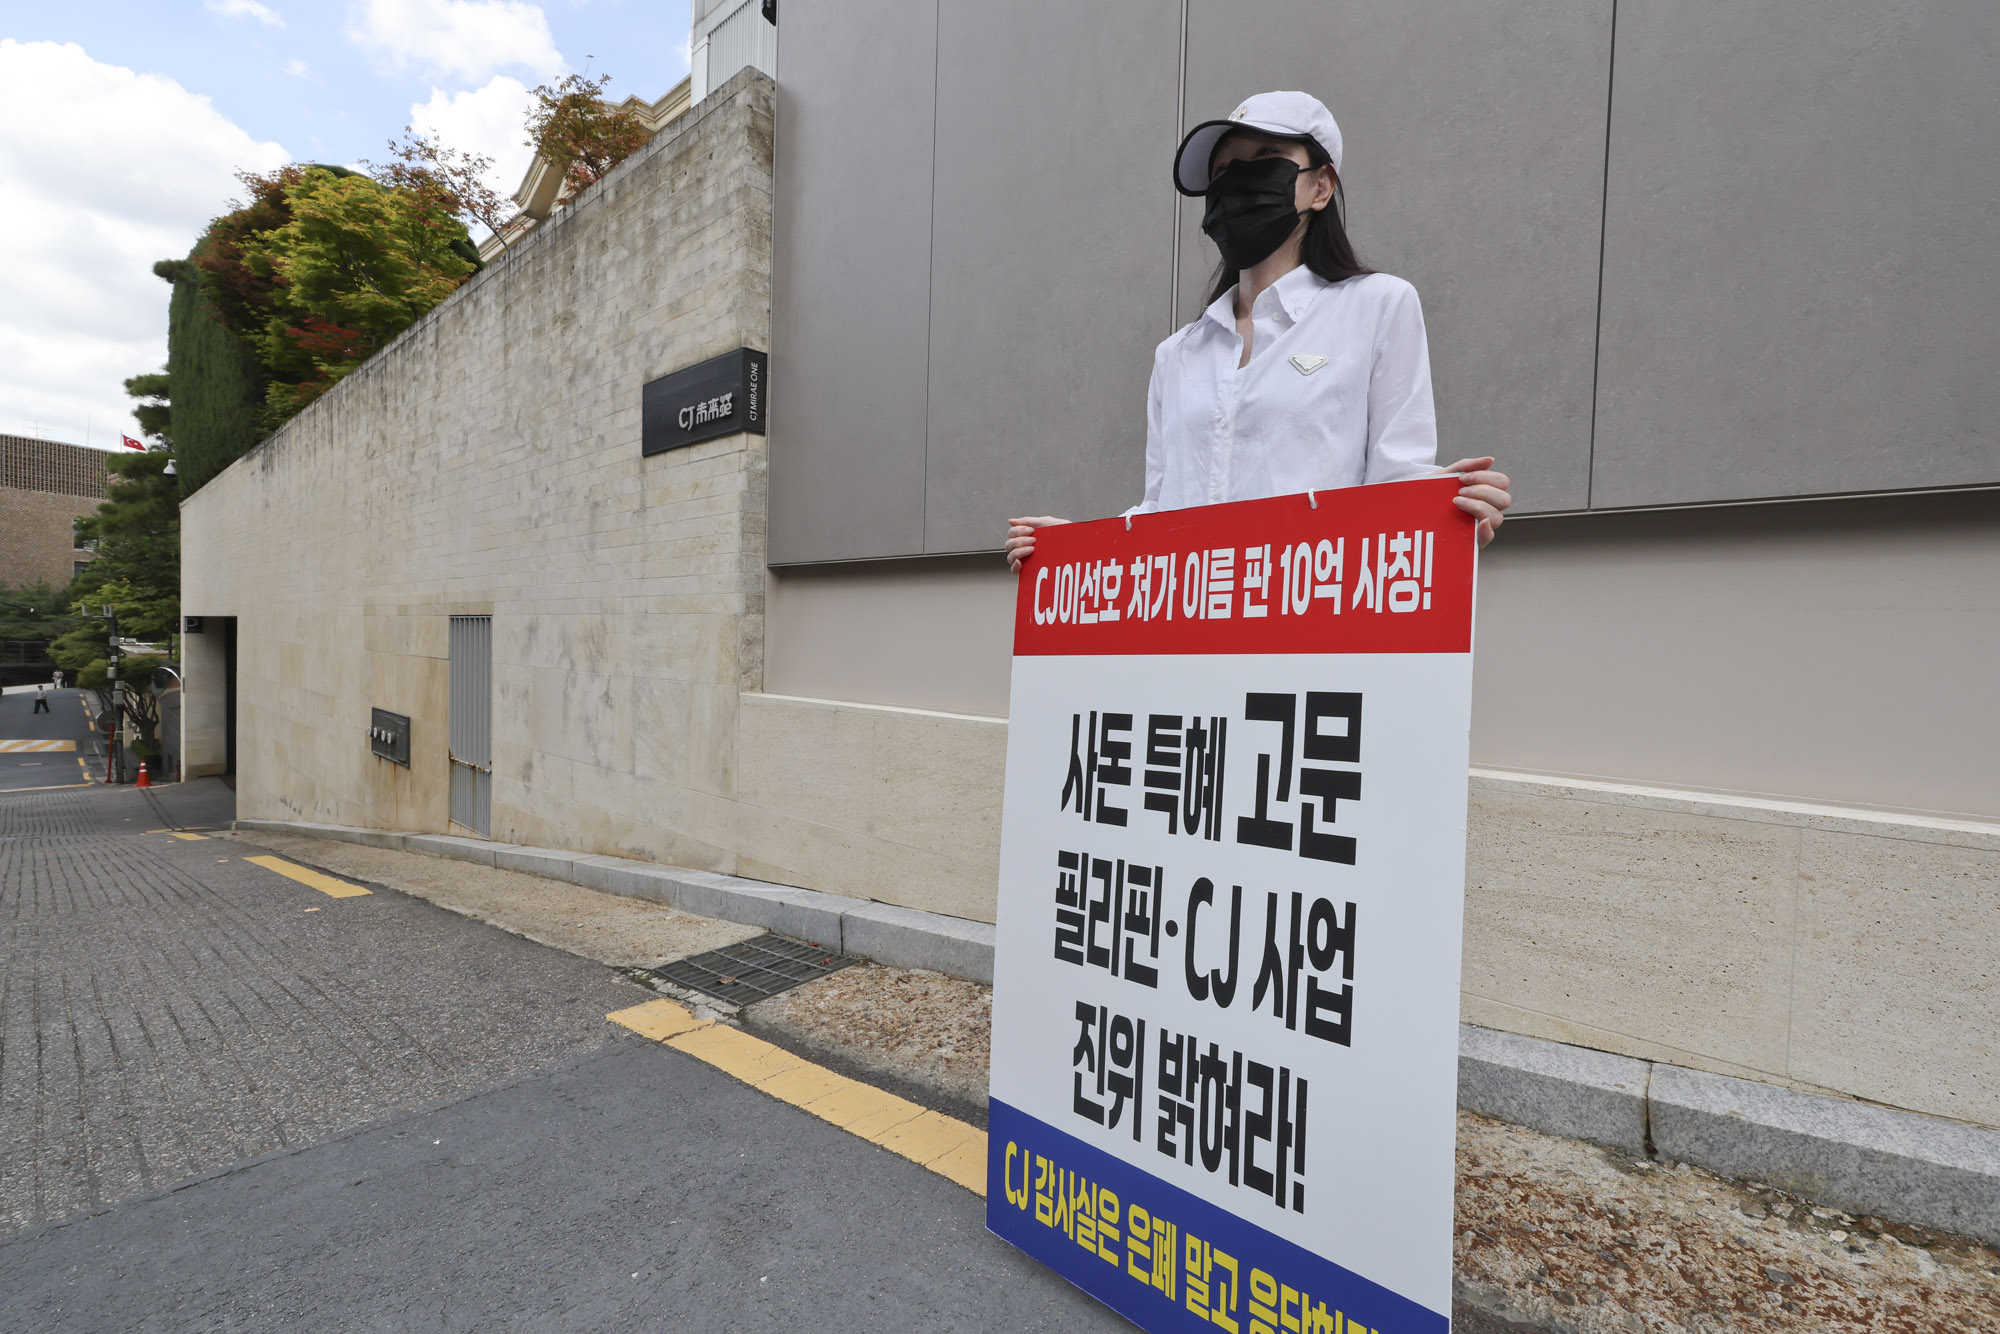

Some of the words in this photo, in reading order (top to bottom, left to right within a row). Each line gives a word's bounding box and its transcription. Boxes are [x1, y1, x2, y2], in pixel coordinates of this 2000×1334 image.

[679, 406, 695, 431] CJ
[750, 410, 758, 421] CJ
[184, 617, 198, 632] P
[1034, 558, 1123, 625] CJ이선호
[1127, 553, 1177, 621] 처가
[1183, 548, 1235, 619] 이름
[1243, 544, 1272, 618] 판
[1280, 537, 1344, 615] 10억
[1352, 530, 1434, 613] 사칭!
[1061, 711, 1133, 827] 사돈
[1144, 714, 1227, 841] 특혜
[1237, 692, 1362, 865] 고문
[1253, 892, 1357, 1045] 사업
[1073, 1001, 1145, 1142] 진위
[1158, 1028, 1308, 1214] 밝혀라!
[1005, 1141, 1029, 1210] CJ
[1036, 1155, 1119, 1267] 감사실은
[1128, 1204, 1176, 1301] 은폐
[1186, 1233, 1239, 1334] 말고
